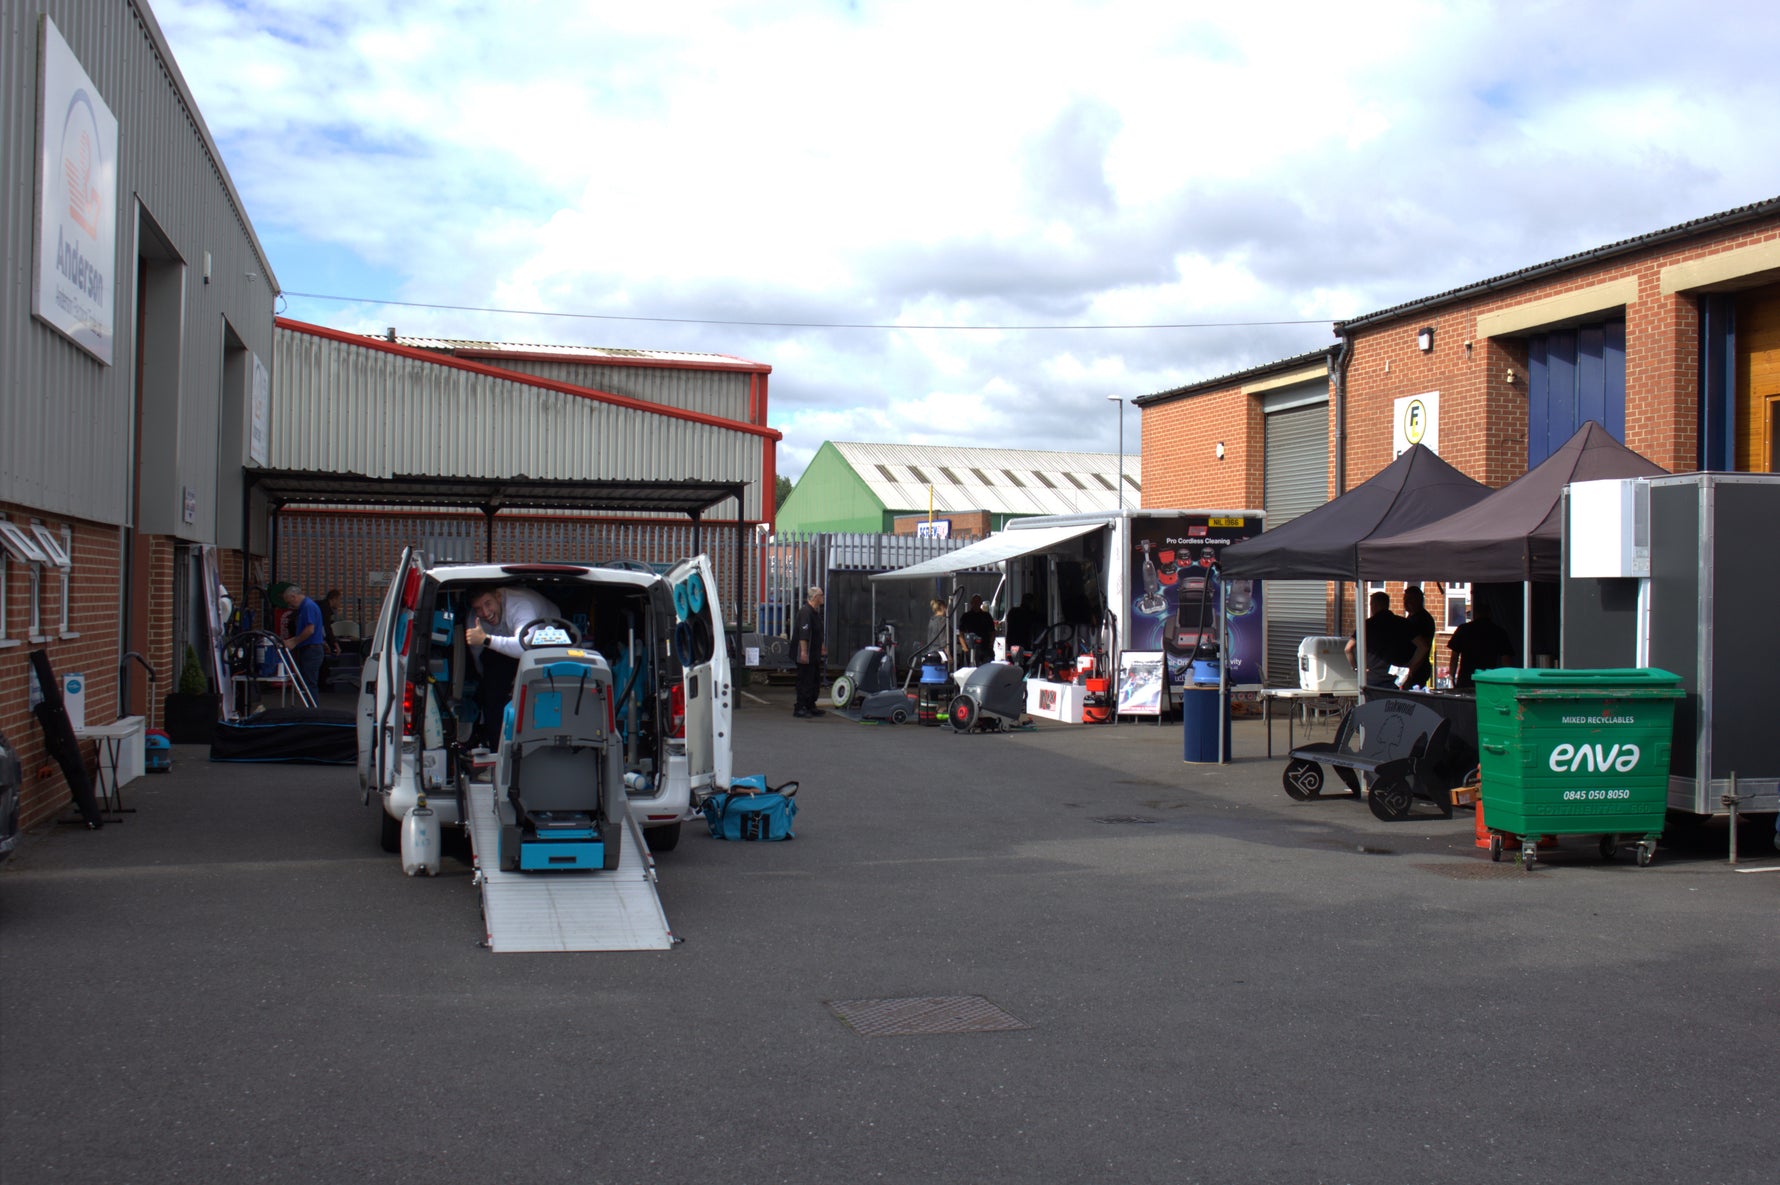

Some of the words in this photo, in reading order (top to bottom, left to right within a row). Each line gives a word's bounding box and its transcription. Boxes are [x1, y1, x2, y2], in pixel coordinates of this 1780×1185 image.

[56, 223, 103, 308] Anderson
[1205, 537, 1231, 546] Cleaning
[1562, 716, 1586, 724] MIXED
[1587, 716, 1634, 724] RECYCLABLES
[1549, 743, 1640, 773] enva
[1563, 791, 1586, 800] 0845
[1588, 790, 1606, 800] 050
[1607, 790, 1630, 799] 8050
